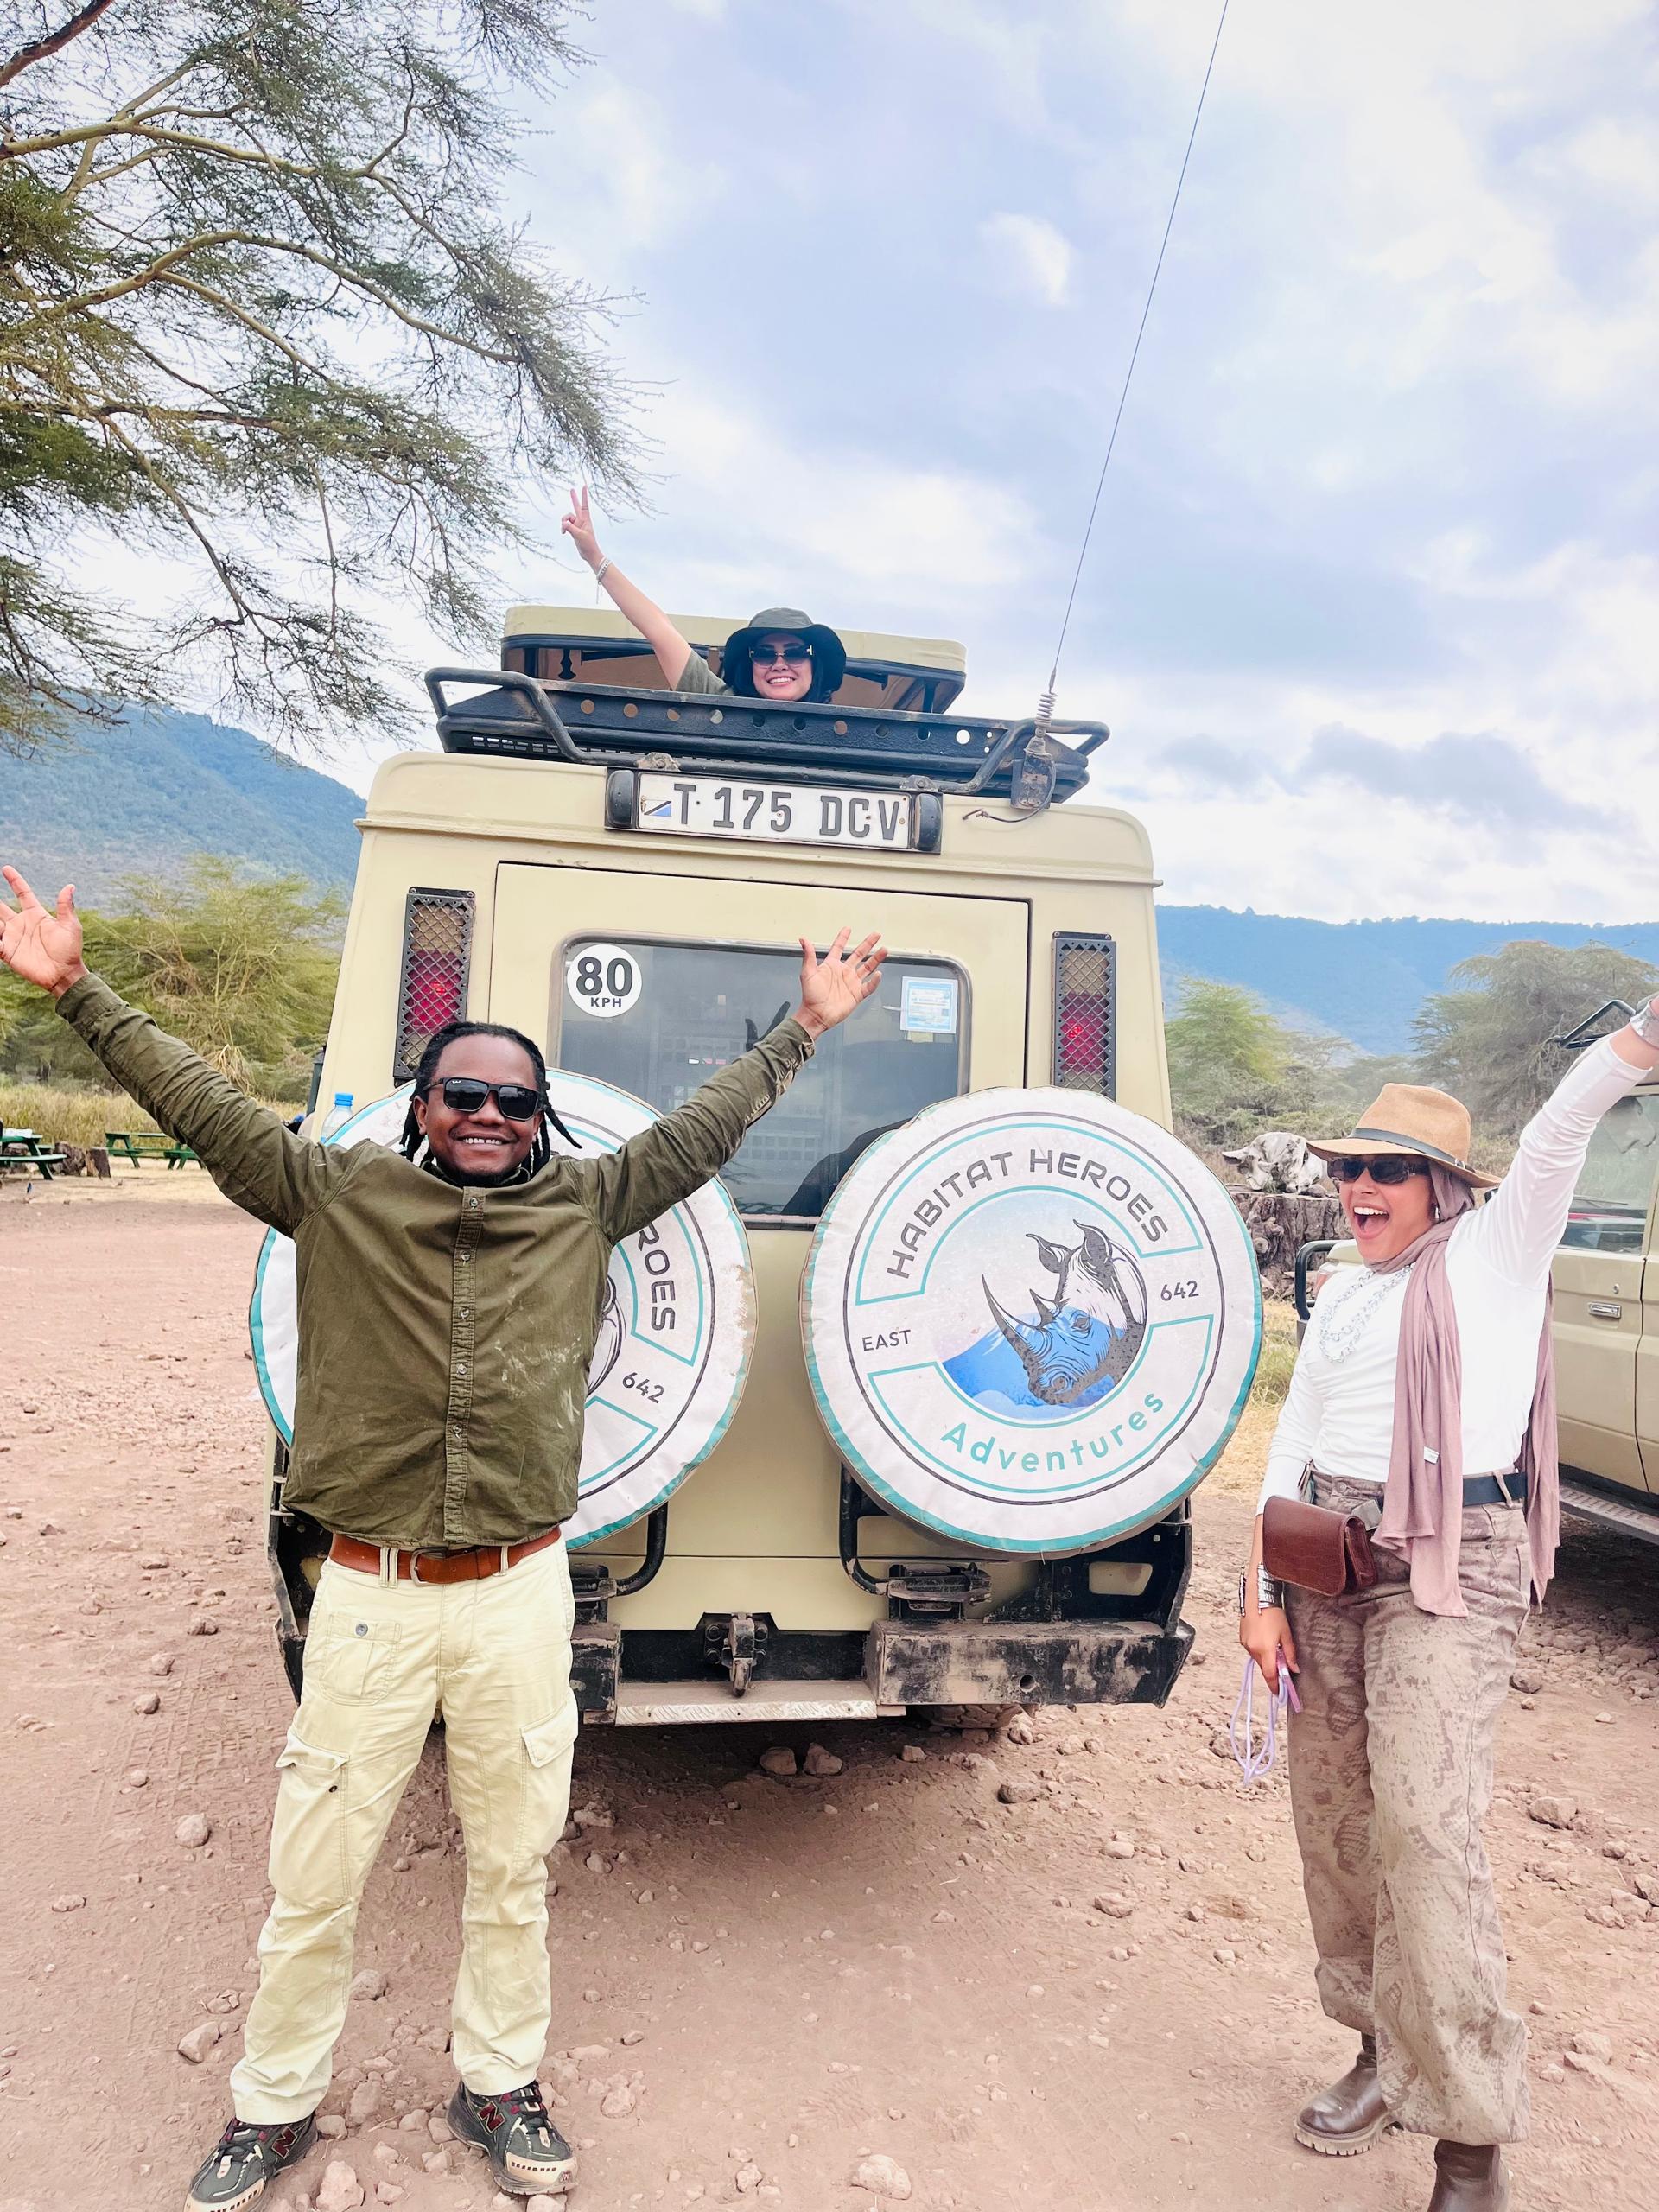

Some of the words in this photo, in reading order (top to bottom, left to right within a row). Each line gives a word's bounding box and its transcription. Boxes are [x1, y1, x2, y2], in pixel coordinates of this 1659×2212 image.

[673, 783, 696, 824] T
[712, 786, 792, 833] 175
[819, 795, 900, 841] DCV
[575, 957, 633, 998] 80
[590, 996, 622, 1008] KPH
[886, 1151, 1013, 1279] HABITAT
[1029, 1148, 1169, 1243] HEROES
[638, 1222, 677, 1331] ROES
[1160, 1280, 1200, 1302] 642
[861, 1329, 912, 1352] EAST
[622, 1372, 664, 1404] 642
[940, 1392, 1164, 1473] Adventures
